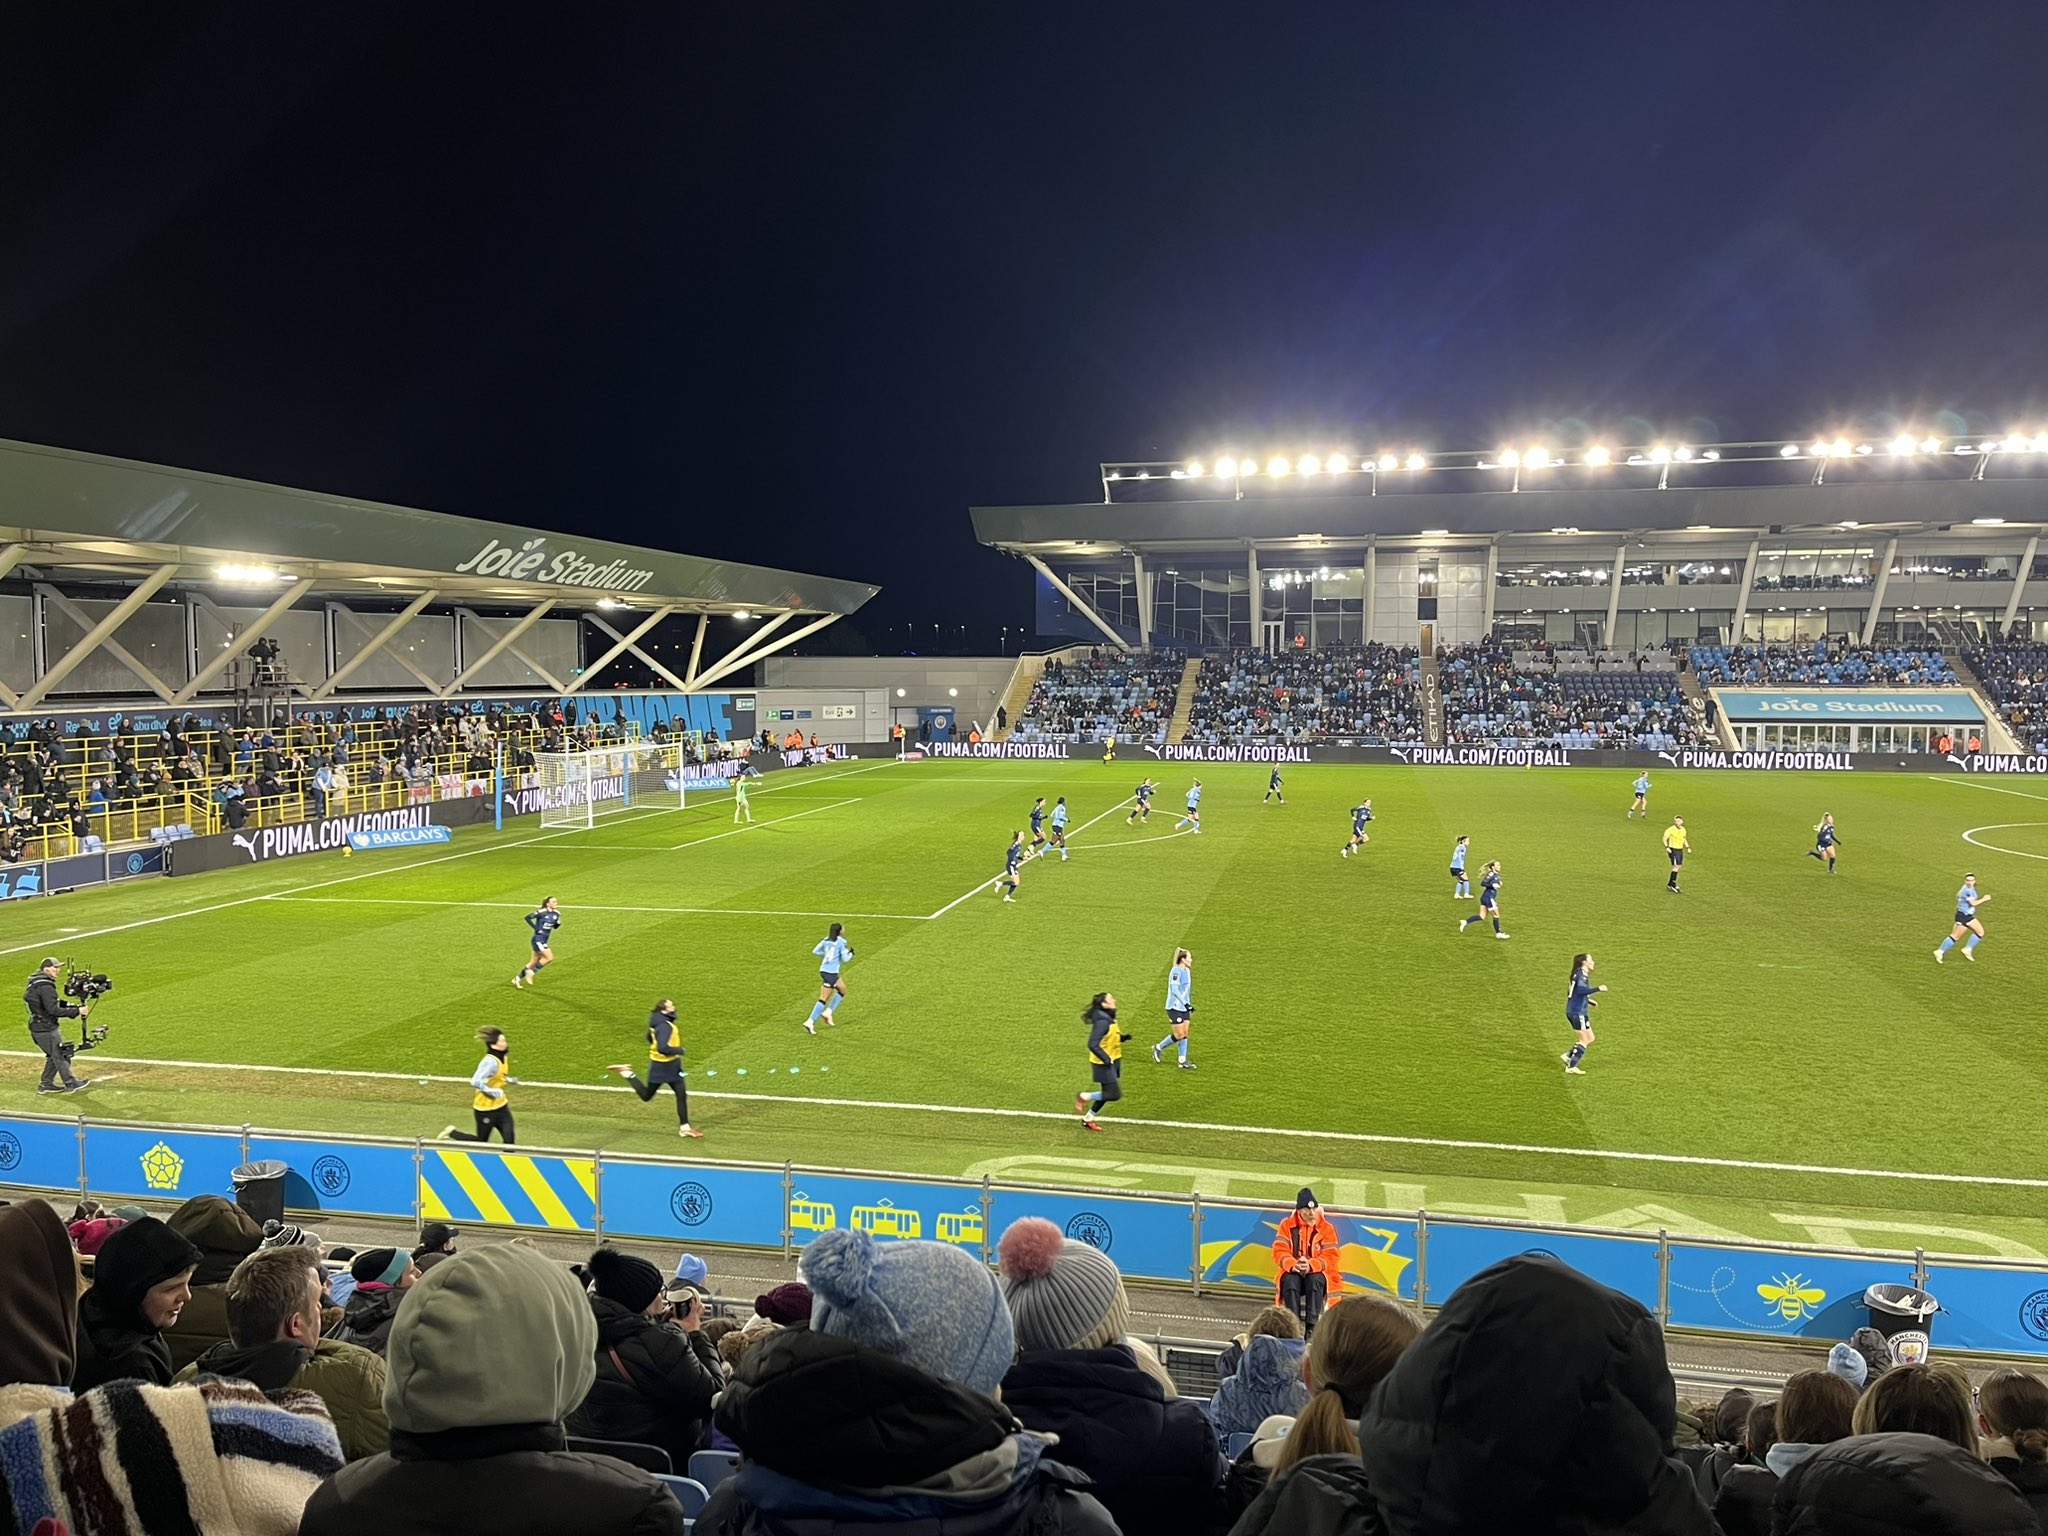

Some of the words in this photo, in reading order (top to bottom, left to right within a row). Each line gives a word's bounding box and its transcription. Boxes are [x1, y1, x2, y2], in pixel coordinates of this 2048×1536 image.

[455, 538, 546, 579] Joie
[537, 551, 654, 591] Stadium
[1426, 674, 1438, 742] ETIHAD
[1758, 697, 1819, 711] Joie
[1825, 701, 1944, 713] Stadium
[934, 742, 1069, 759] PUMA.COM/FOOTBALL
[1165, 744, 1311, 762] PUMA.COM/FOOTBALL
[1413, 748, 1570, 766] PUMA.COM/FOOTBALL
[1683, 751, 1853, 770] PUMA.COM/FOOTBALL
[522, 777, 624, 813] PUMA.COM/FOTBALL
[373, 828, 443, 844] BARCLAYS
